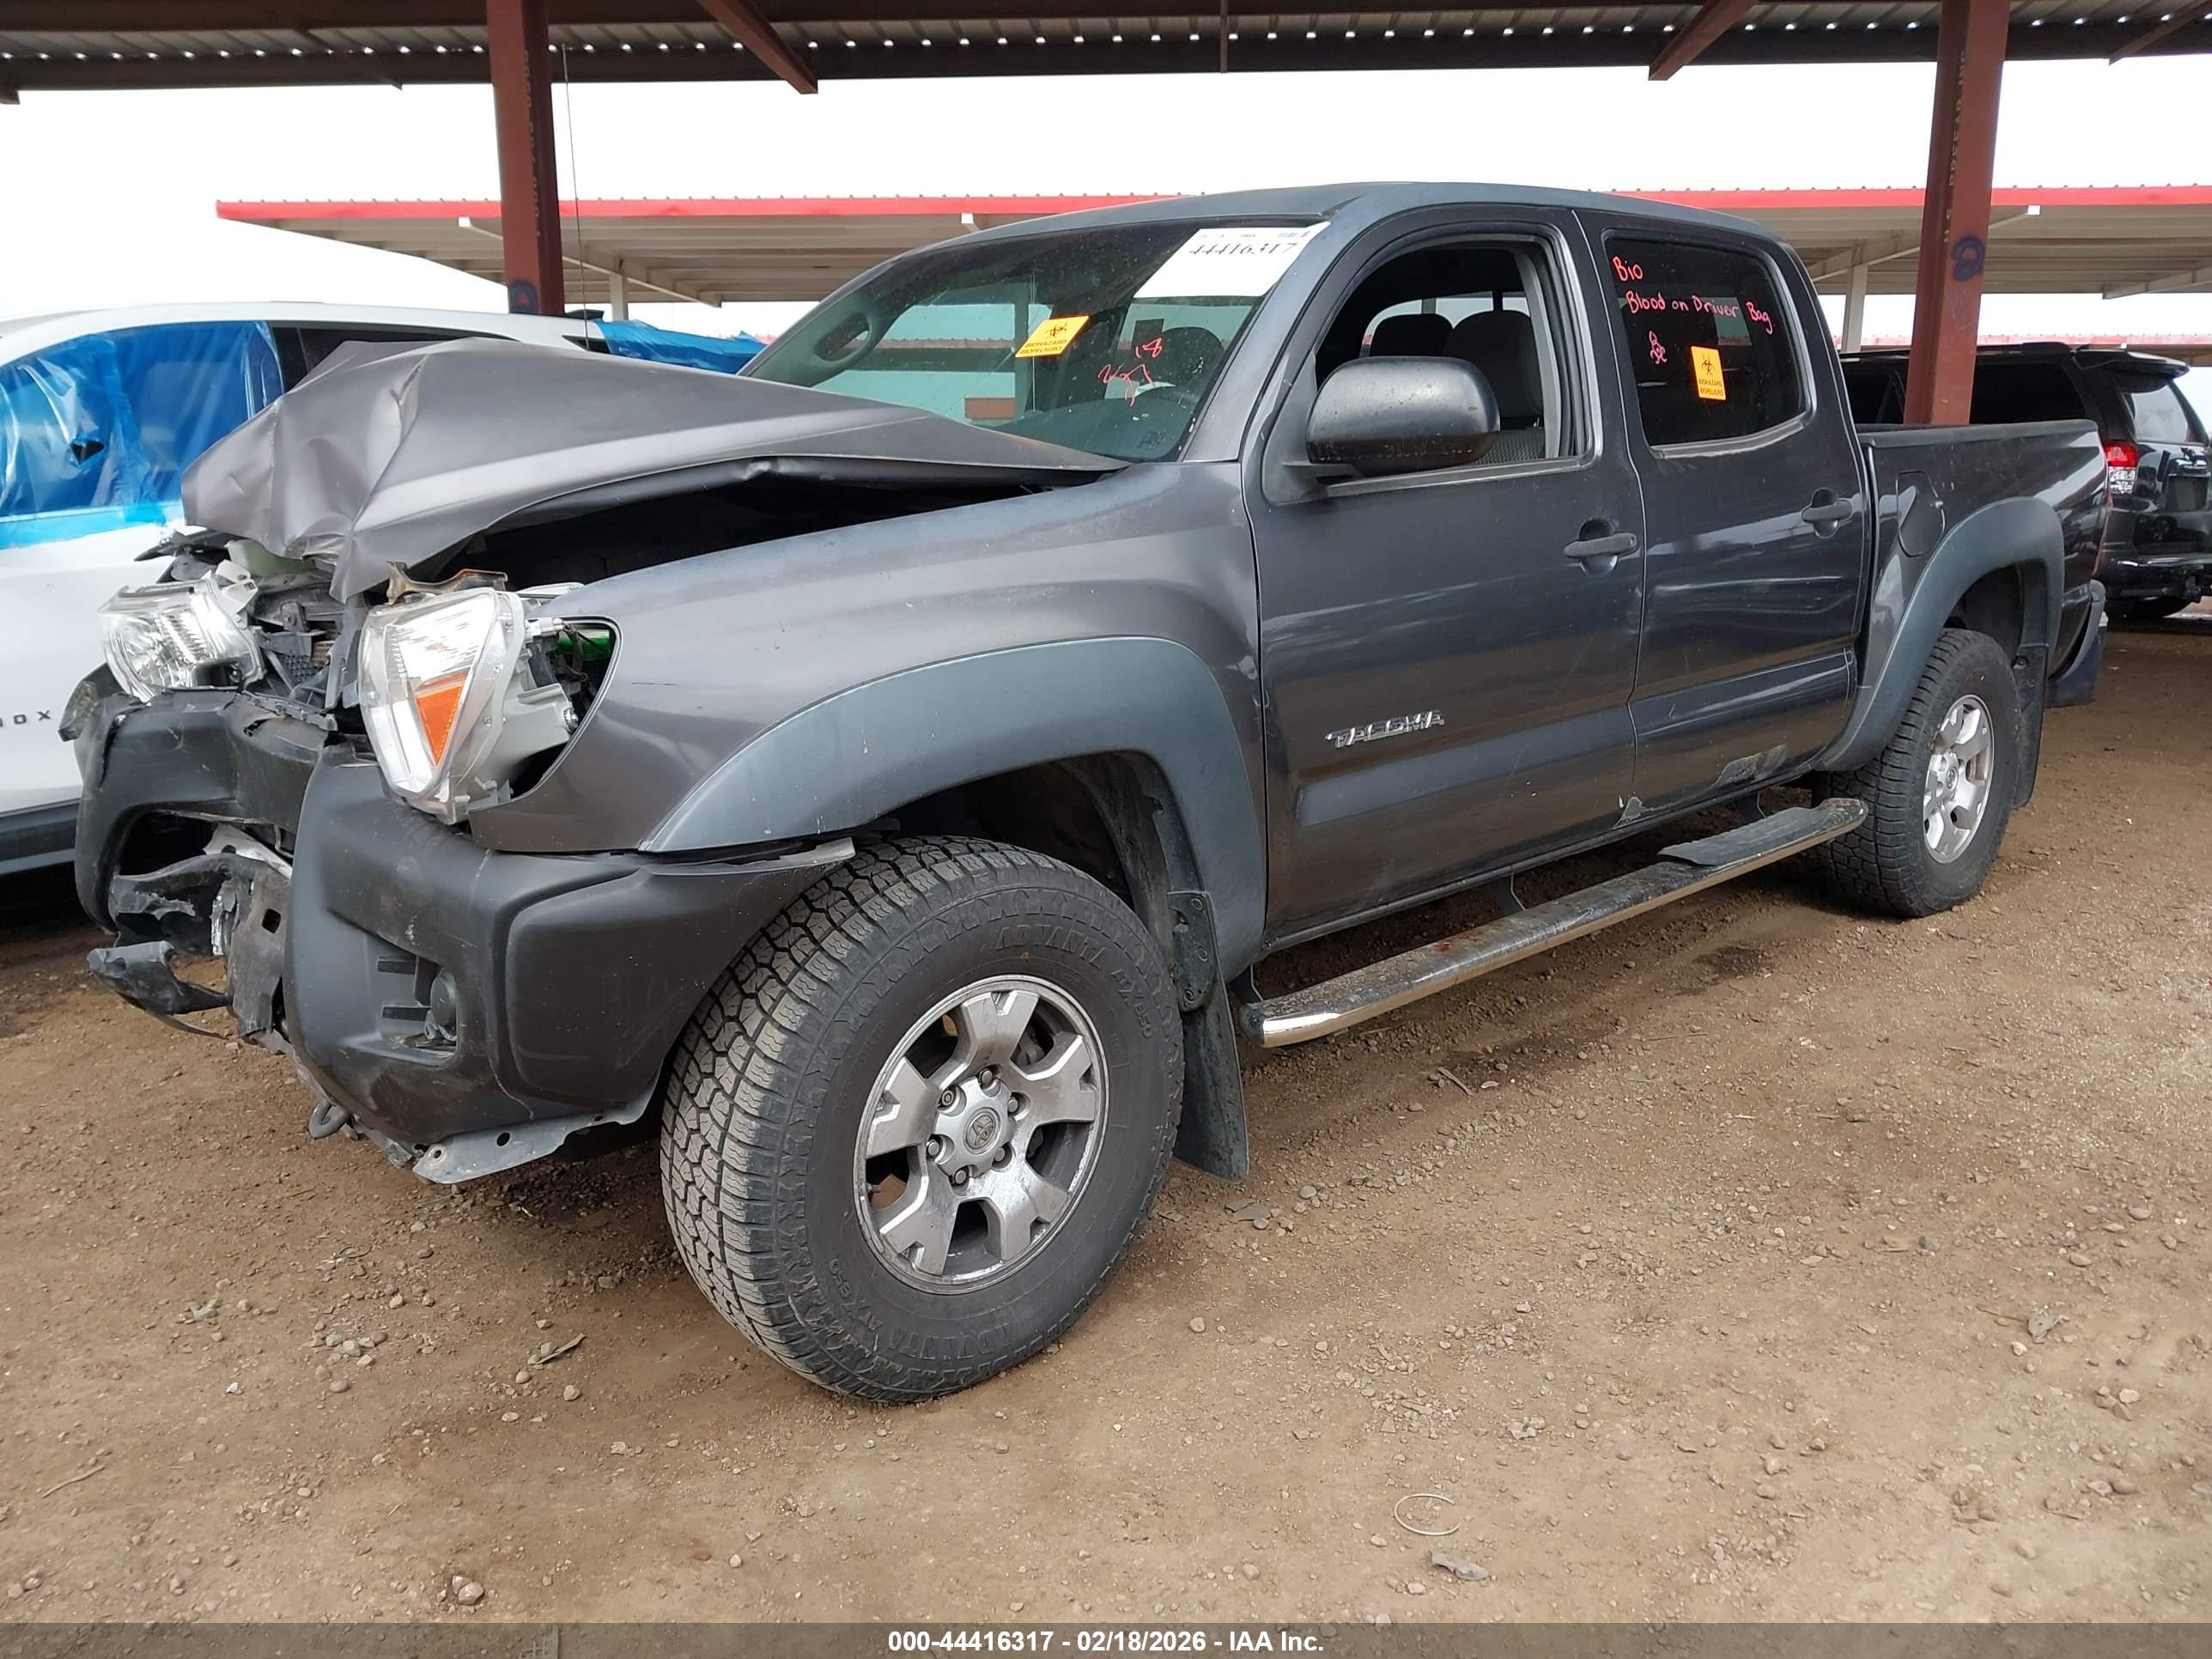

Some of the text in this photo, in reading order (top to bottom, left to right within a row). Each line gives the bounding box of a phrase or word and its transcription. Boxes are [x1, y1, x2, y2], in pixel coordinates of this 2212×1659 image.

[1188, 242, 1299, 255] 44416317
[1613, 256, 1644, 282] Bio
[1626, 290, 1773, 335] Blood on Driver Bag
[1024, 339, 1067, 348] BIOHAZARD
[1698, 378, 1723, 387] BIOHAZARD
[1324, 709, 1445, 749] TACOMA
[996, 924, 1106, 971] ADVANTA
